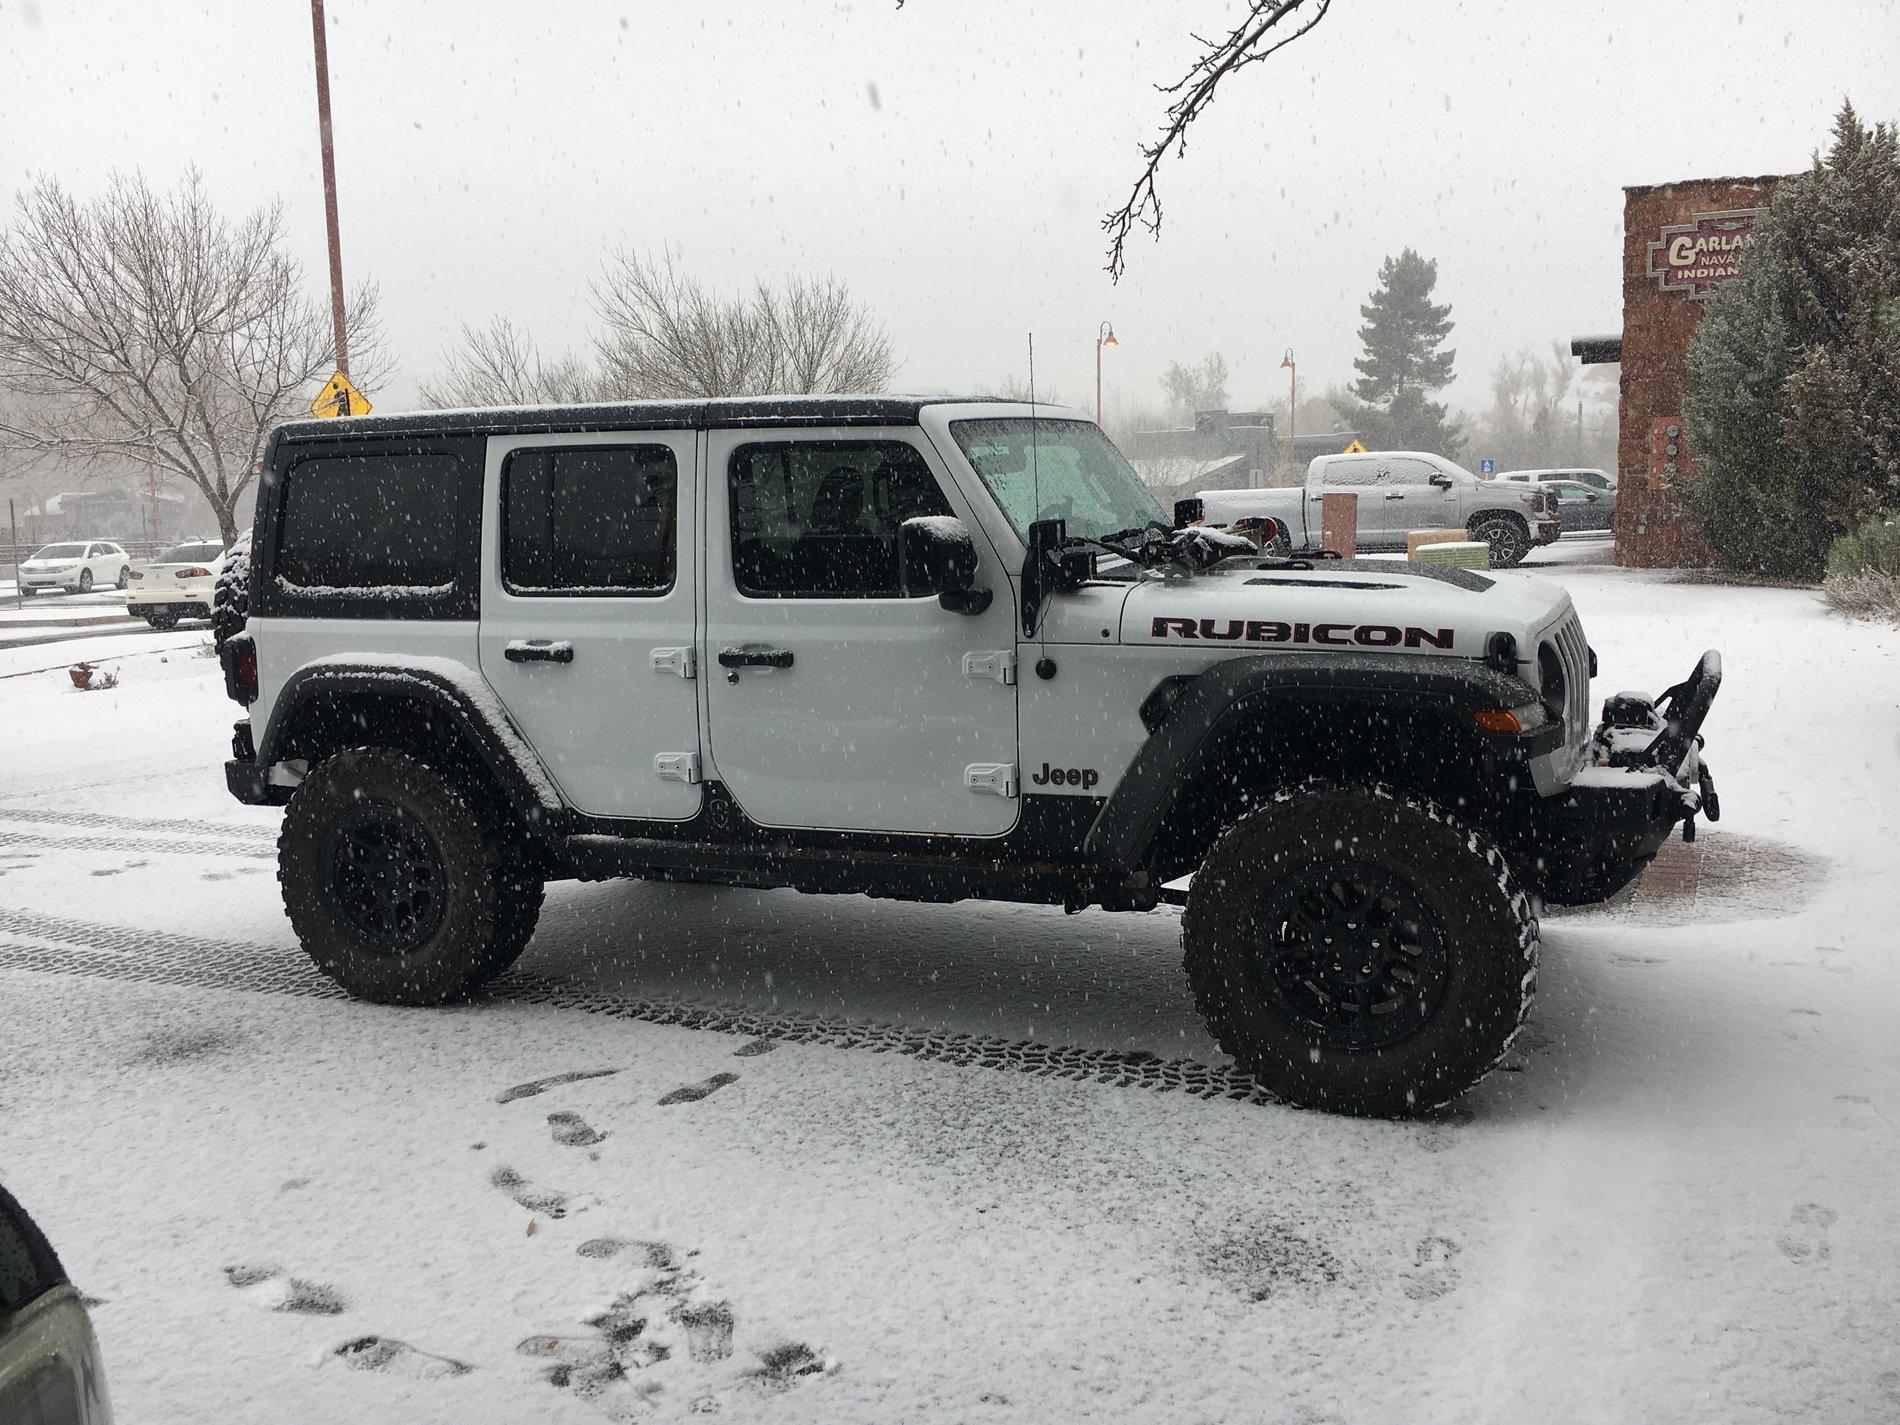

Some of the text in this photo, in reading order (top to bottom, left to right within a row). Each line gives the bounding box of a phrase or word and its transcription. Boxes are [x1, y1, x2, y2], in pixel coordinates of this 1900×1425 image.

[1677, 266, 1739, 279] INDIAN
[1151, 617, 1455, 649] RUBICON
[1032, 762, 1099, 790] Jeep
